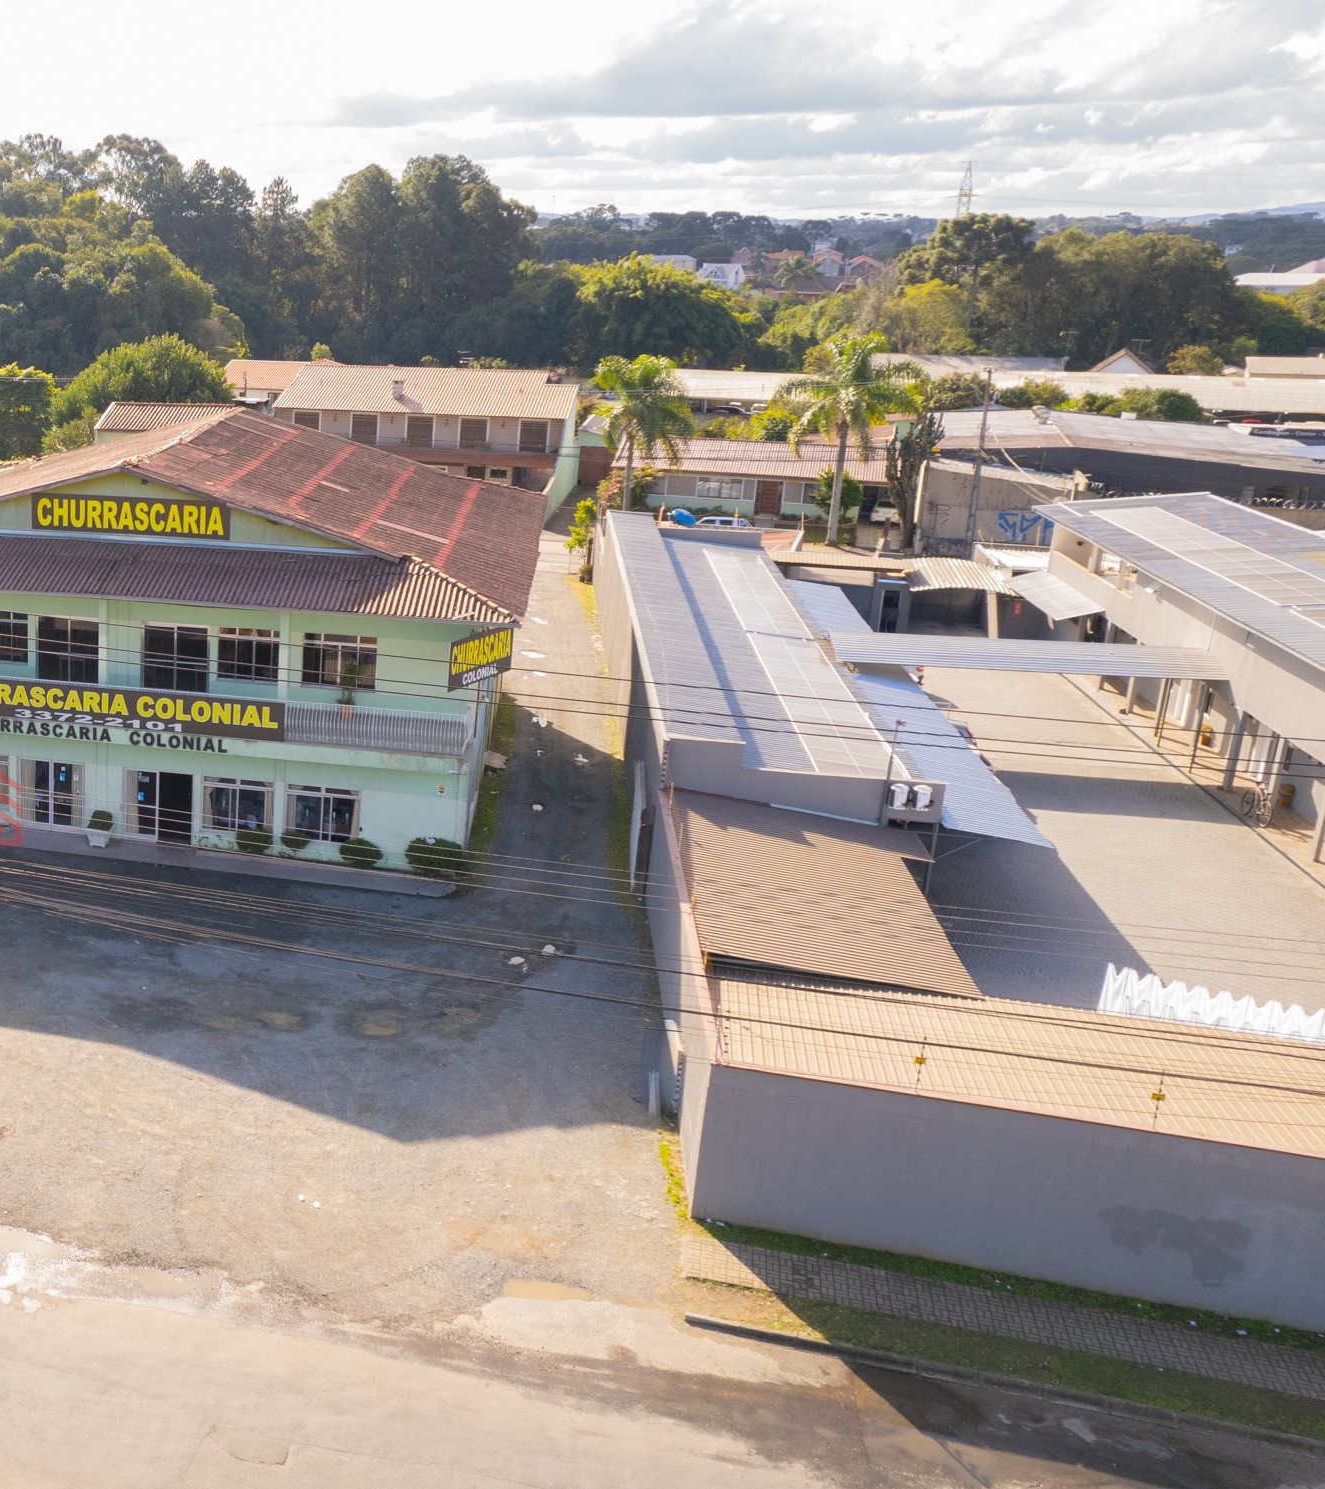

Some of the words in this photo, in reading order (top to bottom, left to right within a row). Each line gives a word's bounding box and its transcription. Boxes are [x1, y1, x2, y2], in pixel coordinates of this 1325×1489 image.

[37, 497, 224, 535] CHURRASCARIA
[451, 628, 512, 675] CHURRASCARIA
[462, 664, 498, 685] COLONIAL
[15, 709, 182, 733] 3372-2101
[136, 696, 278, 729] COLONIAL
[129, 731, 228, 753] COLONIAL
